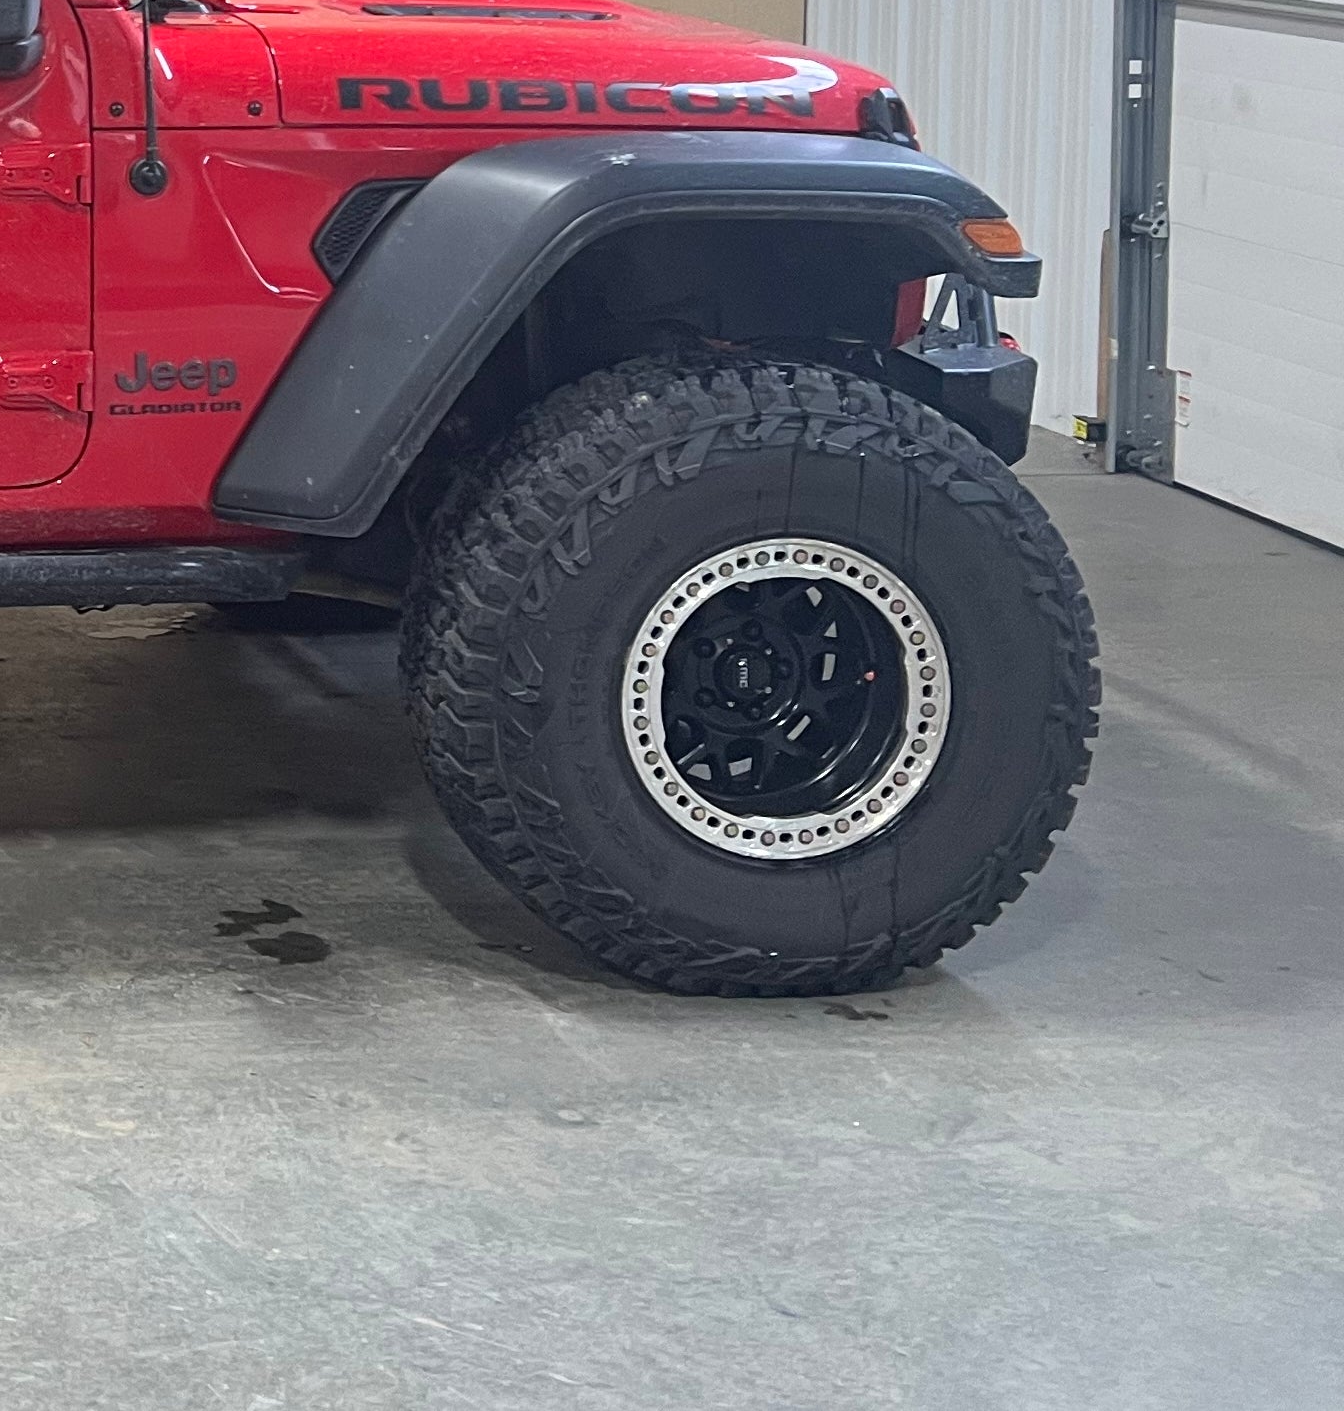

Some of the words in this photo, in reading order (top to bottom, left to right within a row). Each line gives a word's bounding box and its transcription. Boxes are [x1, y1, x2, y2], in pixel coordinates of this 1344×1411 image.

[337, 76, 814, 118] RUBICON
[115, 350, 238, 397] Jeep
[109, 400, 242, 416] GLADIATOR
